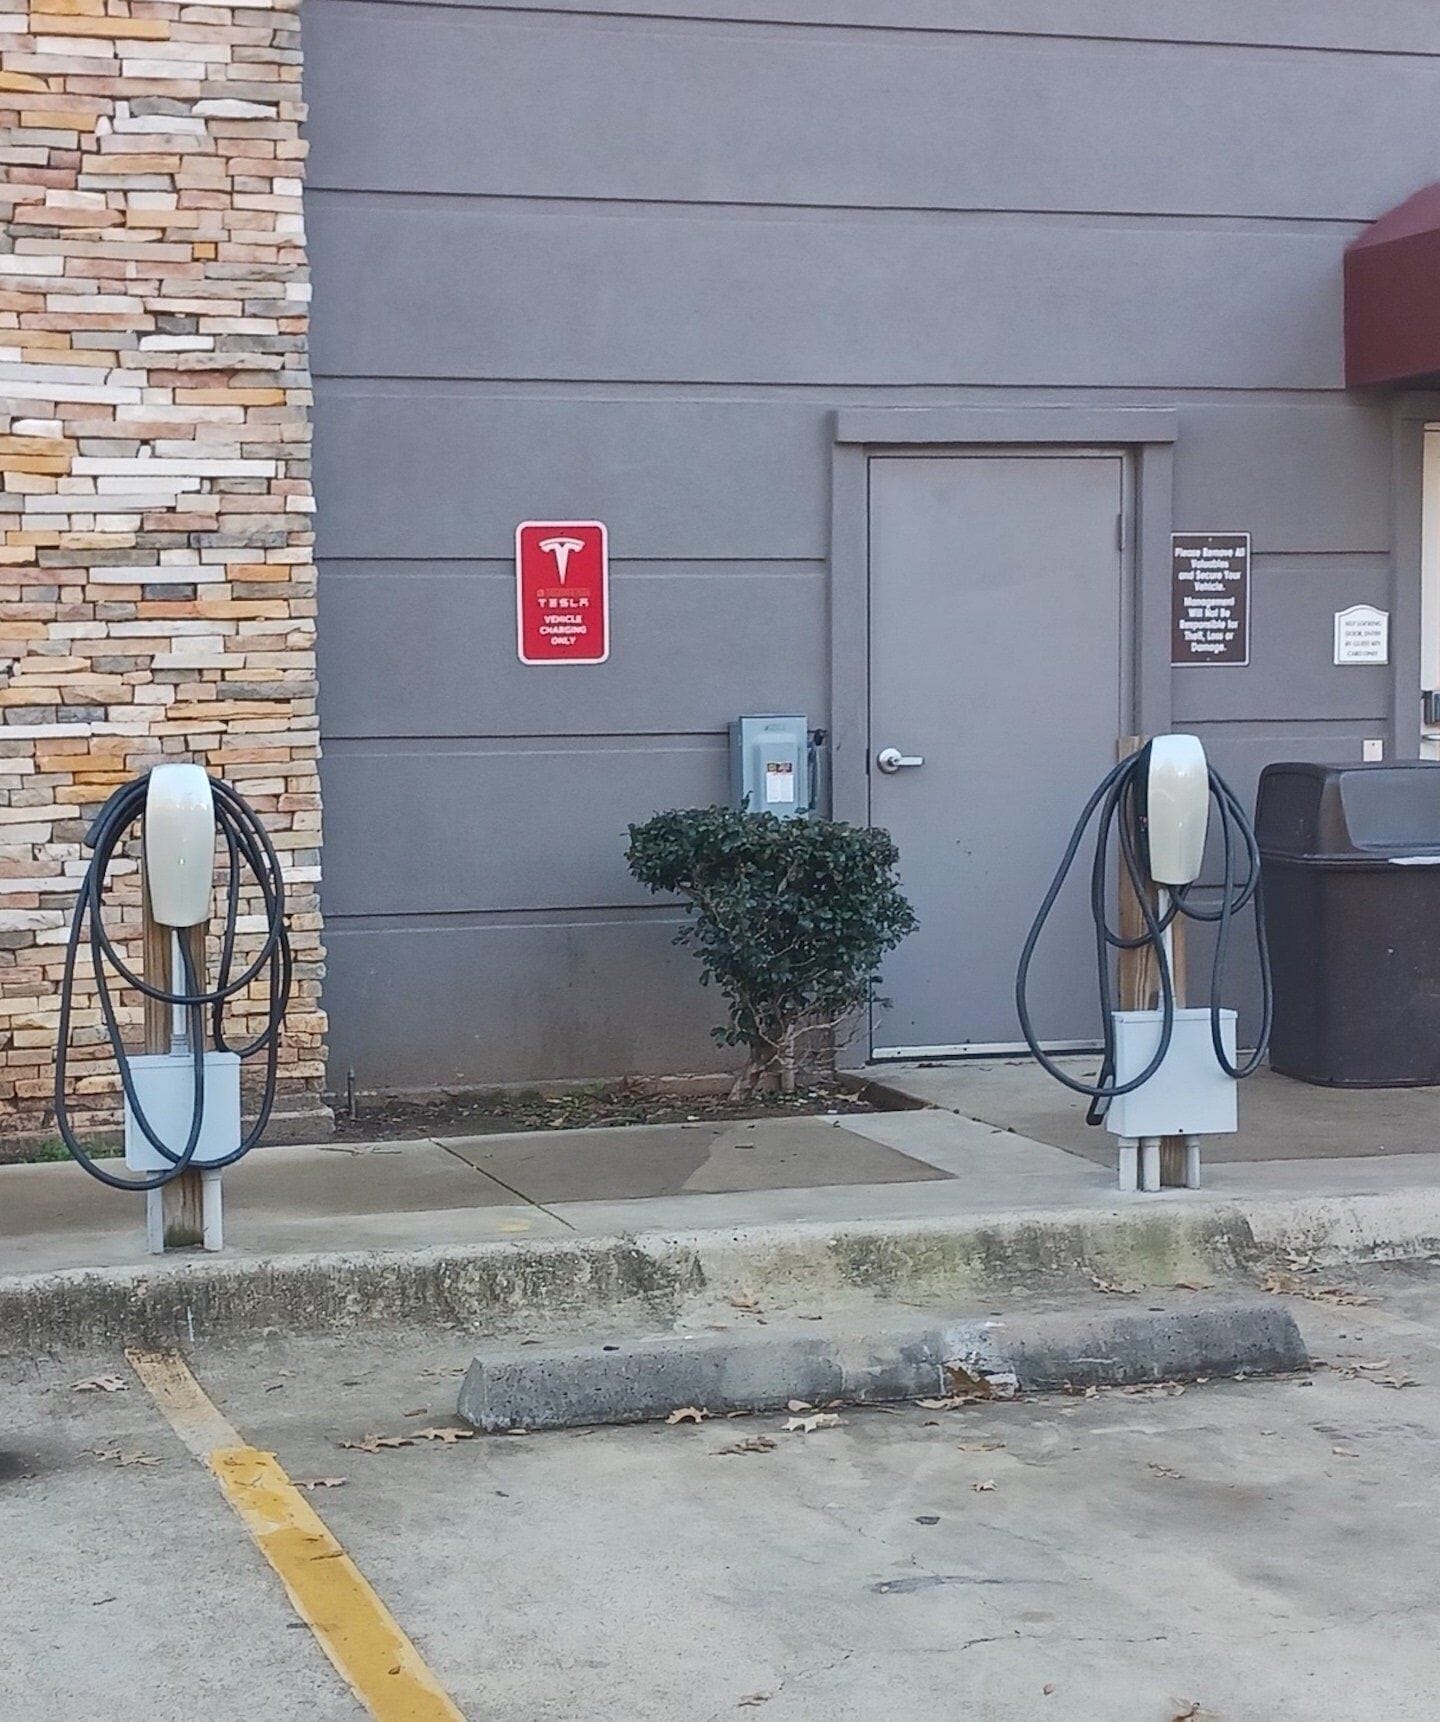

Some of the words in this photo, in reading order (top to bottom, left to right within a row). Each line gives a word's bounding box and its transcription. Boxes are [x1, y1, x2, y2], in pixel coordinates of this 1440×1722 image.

[1178, 571, 1194, 580] and
[537, 598, 589, 608] TESLA
[544, 615, 582, 624] VEHICLE
[539, 625, 587, 635] CHARGING
[551, 636, 576, 645] ONLY
